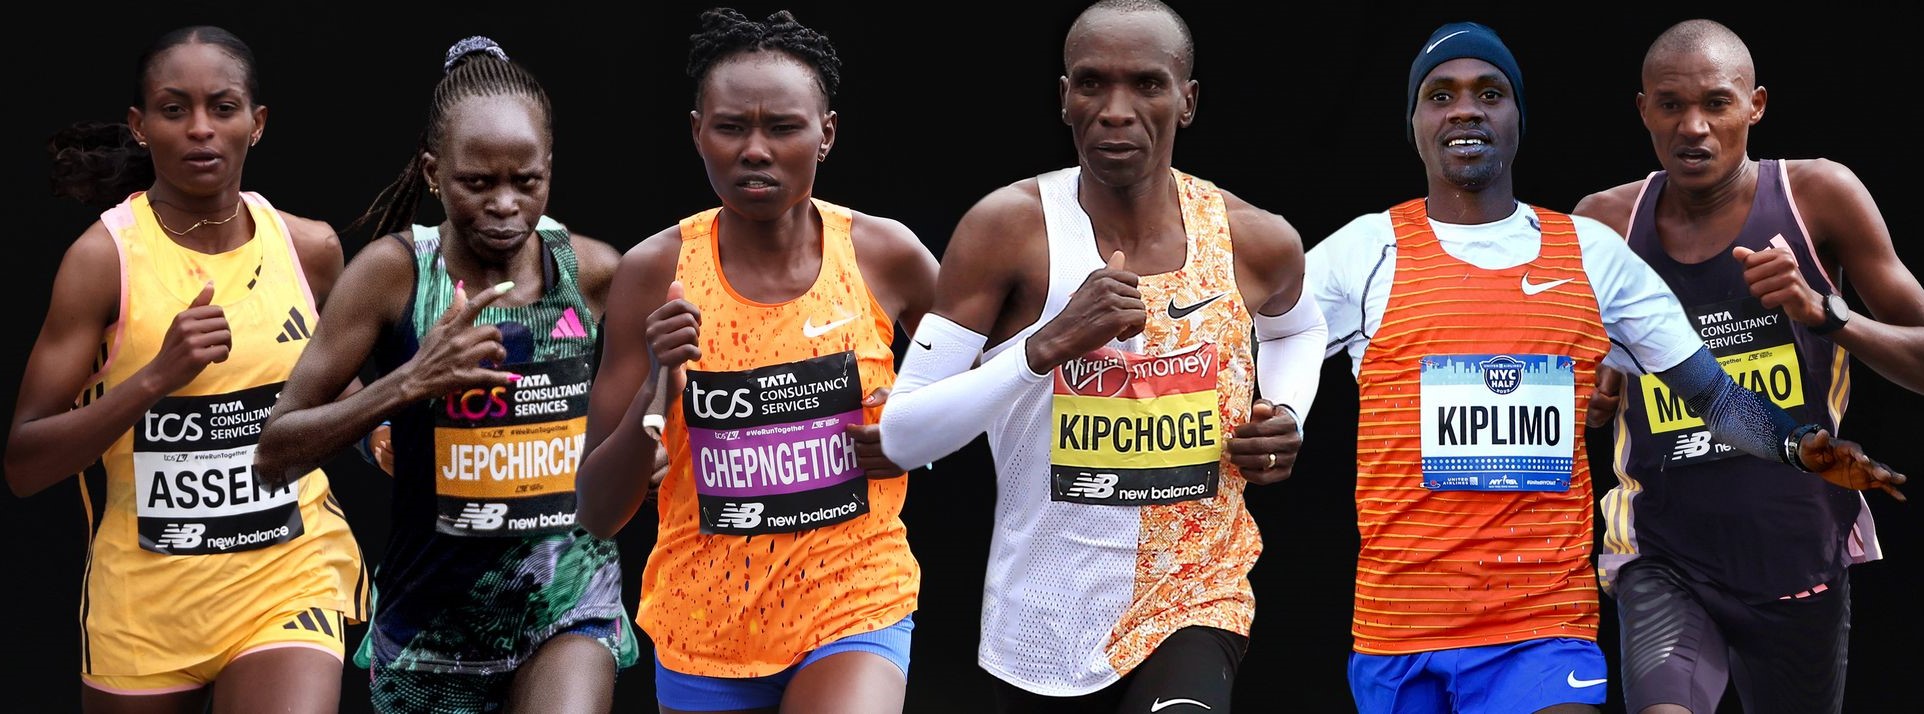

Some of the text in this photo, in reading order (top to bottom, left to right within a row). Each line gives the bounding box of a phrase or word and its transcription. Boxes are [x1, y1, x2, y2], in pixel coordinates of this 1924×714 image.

[1698, 311, 1733, 325] TATA
[1700, 314, 1778, 338] CONSULTANCY
[1703, 332, 1754, 350] SERVICES
[515, 373, 551, 387] TATA
[757, 373, 797, 388] TATA
[1065, 352, 1212, 392] Virgin money
[1489, 369, 1516, 380] NYC
[514, 382, 588, 402] CONSULTANCY
[760, 376, 849, 401] CONSULTANCY
[1491, 380, 1514, 388] HALF
[209, 400, 244, 414] TATA
[514, 400, 568, 416] SERVICES
[692, 380, 753, 419] tcs
[762, 397, 820, 415] SERVICES
[144, 409, 203, 442] tcs
[209, 405, 276, 427] CONSULTAN
[1438, 405, 1560, 446] KIPLIMO
[210, 424, 262, 440] SERVICES
[746, 425, 805, 437] #WeRunTogether
[1059, 410, 1215, 453] KIPCHOGE
[442, 433, 586, 481] JEPCHIRCHI
[700, 432, 858, 488] CHEPNGETICH
[148, 465, 291, 509] ASSE
[1119, 487, 1149, 499] new
[1151, 483, 1206, 499] balance
[508, 516, 538, 529] new
[539, 511, 576, 527] bala
[767, 514, 797, 527] new
[800, 501, 857, 524] balance
[207, 537, 236, 549] new
[238, 525, 289, 545] balance
